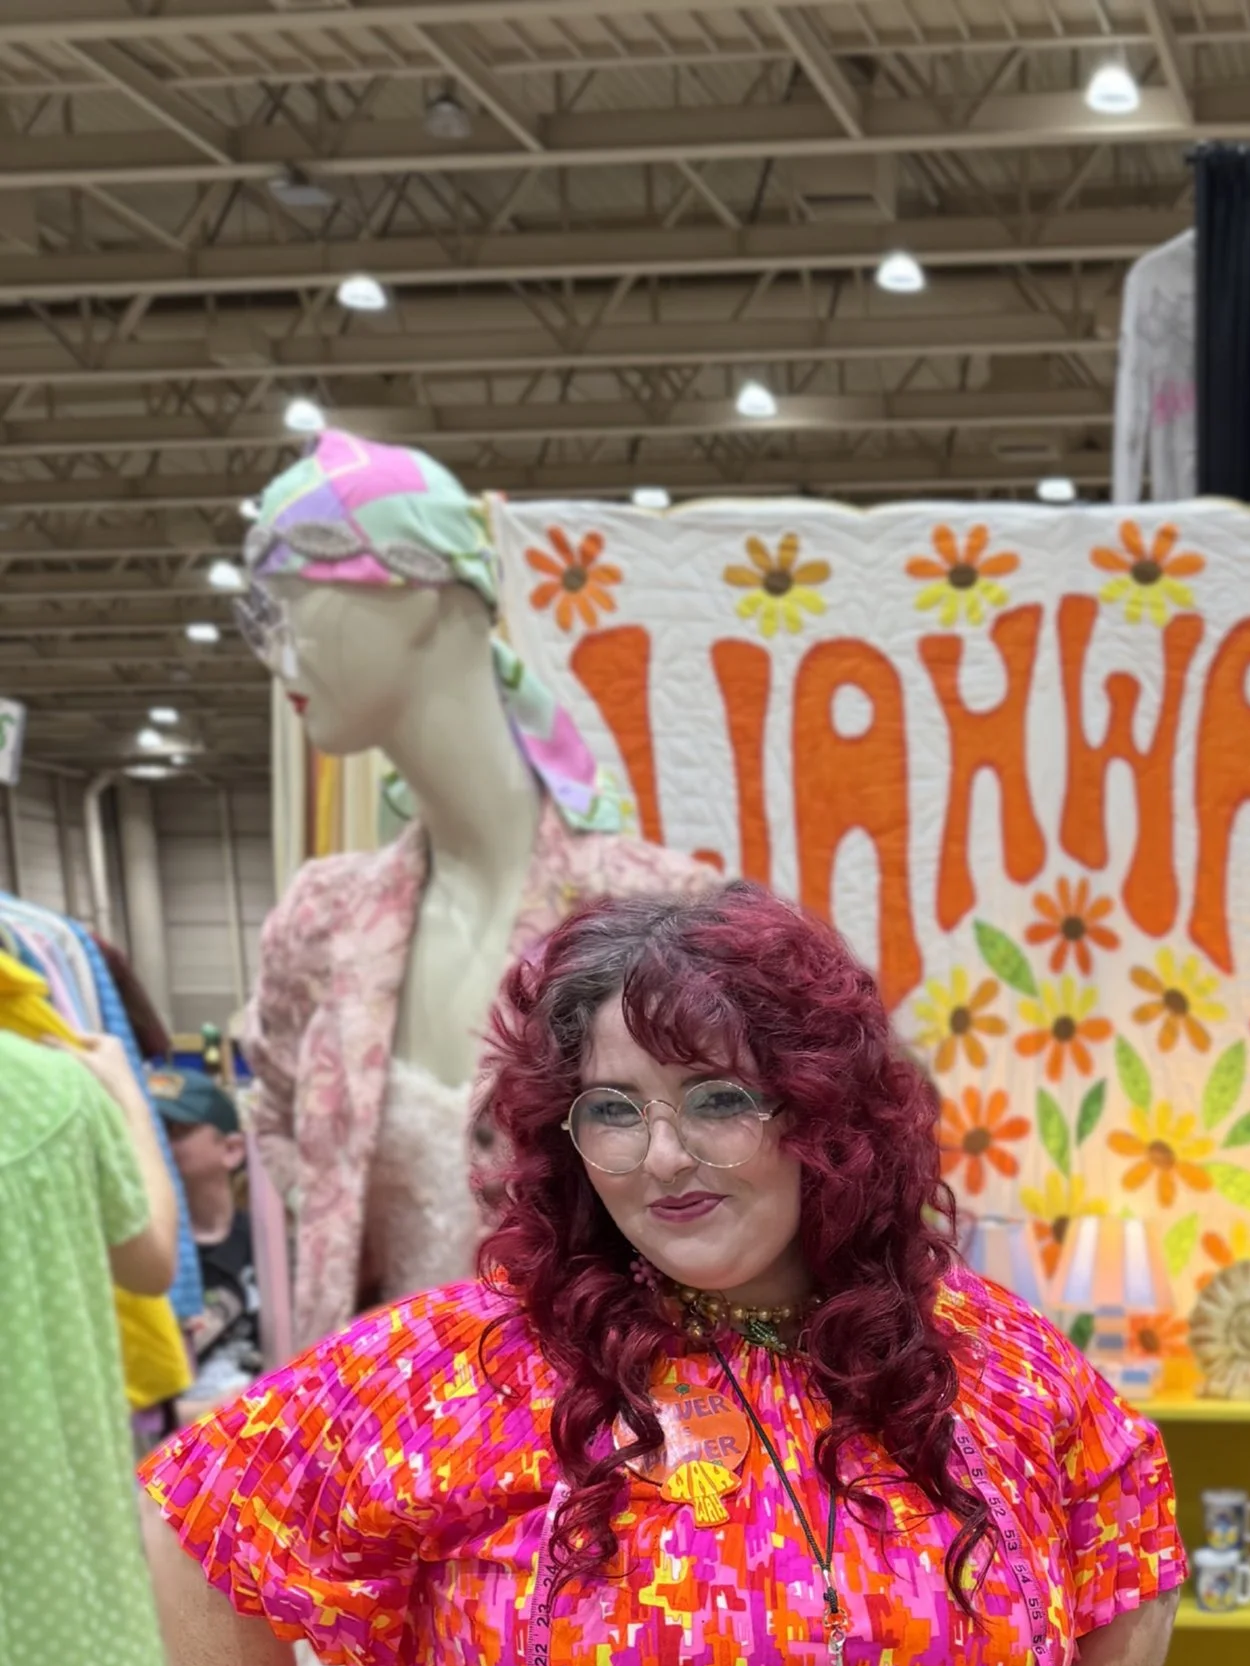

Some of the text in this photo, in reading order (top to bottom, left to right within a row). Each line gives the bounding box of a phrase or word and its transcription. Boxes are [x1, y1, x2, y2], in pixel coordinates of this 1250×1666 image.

[666, 1460, 735, 1500] WAH
[694, 1496, 729, 1523] WAH
[957, 1435, 976, 1456] 50
[988, 1496, 1007, 1518] 52
[1004, 1529, 1018, 1551] 53
[1014, 1563, 1031, 1585] 54
[1028, 1597, 1042, 1620] 55
[536, 1602, 551, 1628] 23
